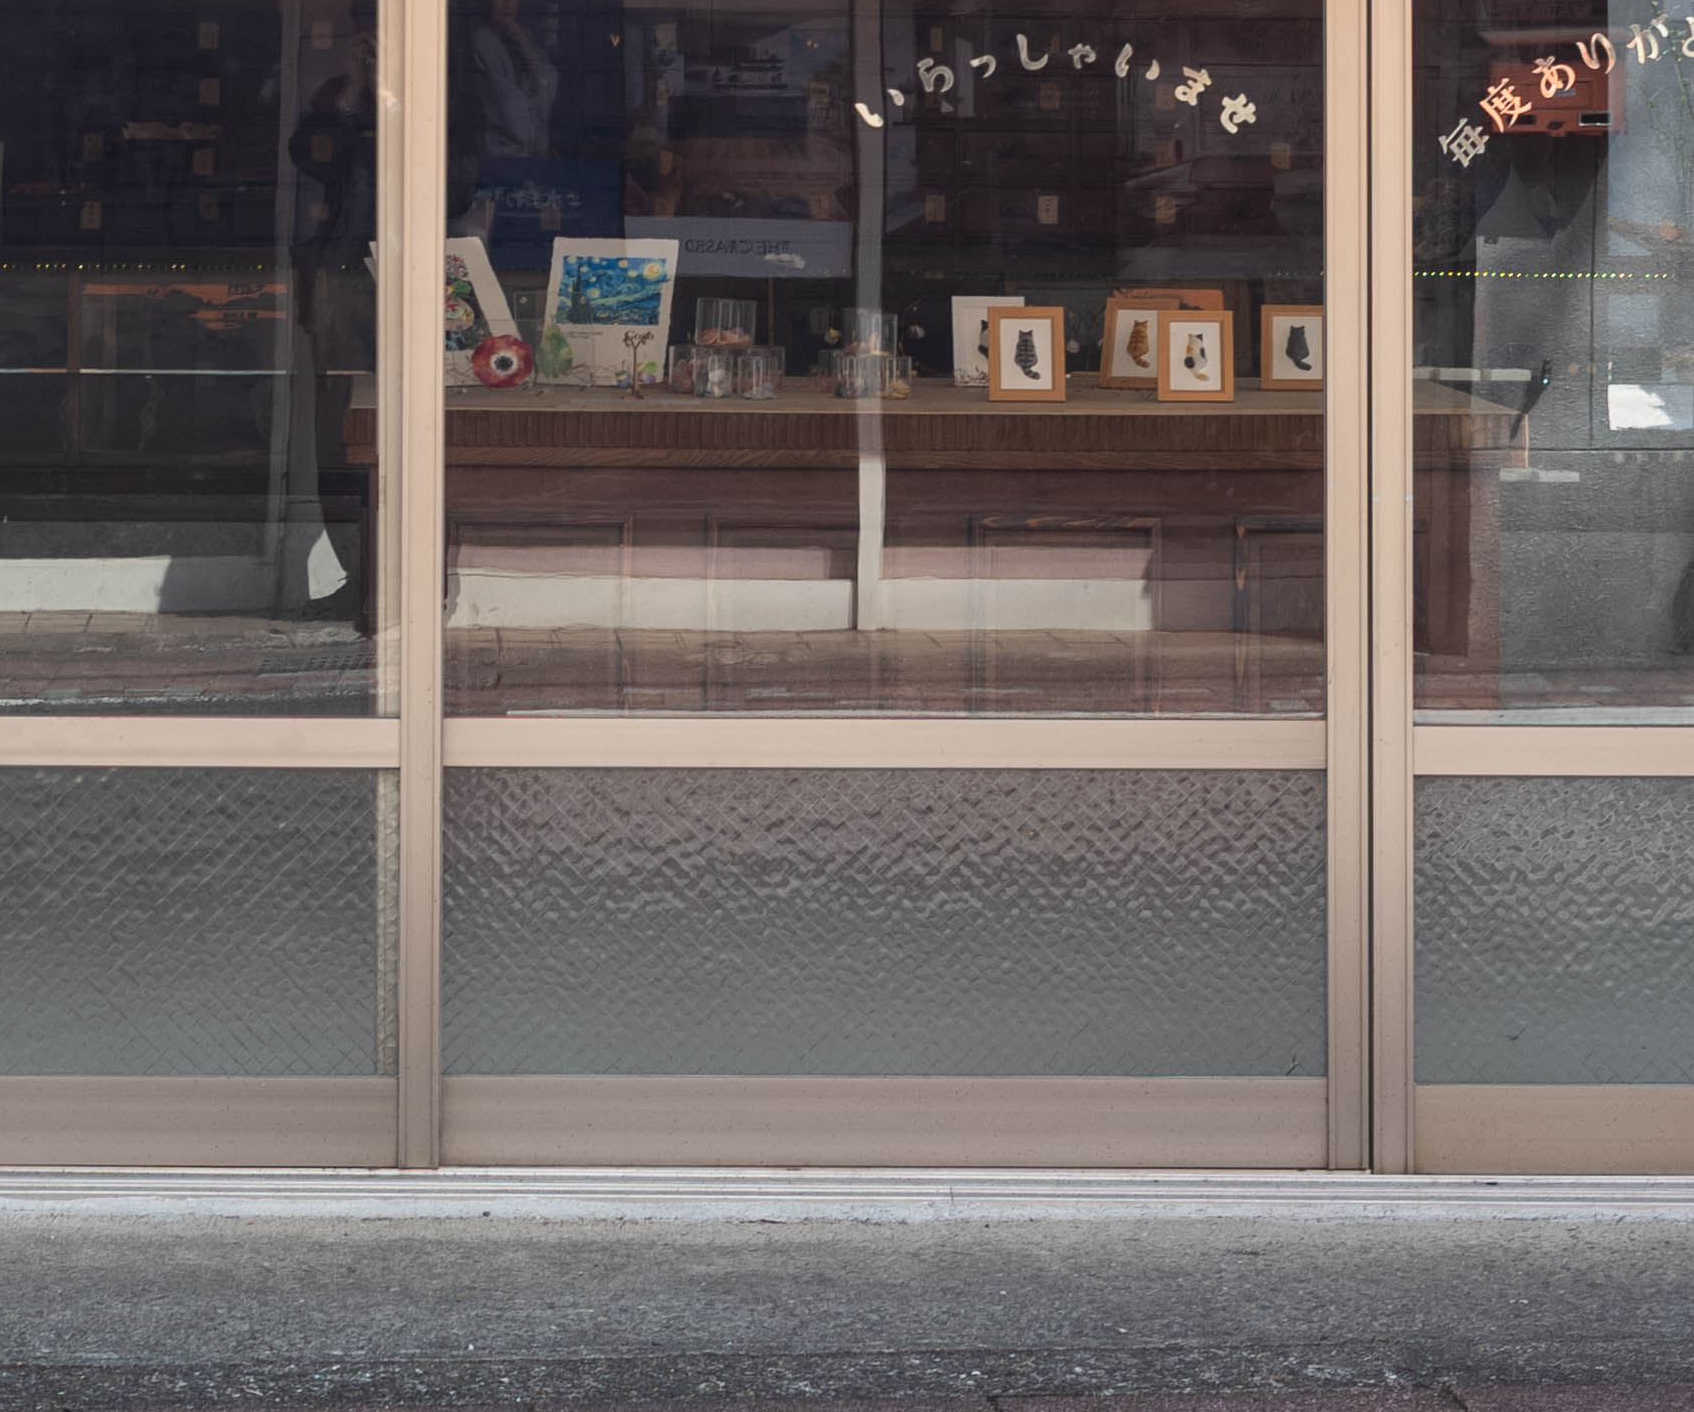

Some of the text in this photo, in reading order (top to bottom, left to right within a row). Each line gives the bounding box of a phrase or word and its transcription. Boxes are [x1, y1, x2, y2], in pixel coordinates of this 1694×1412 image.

[854, 33, 1257, 134] いらっしゃいませ
